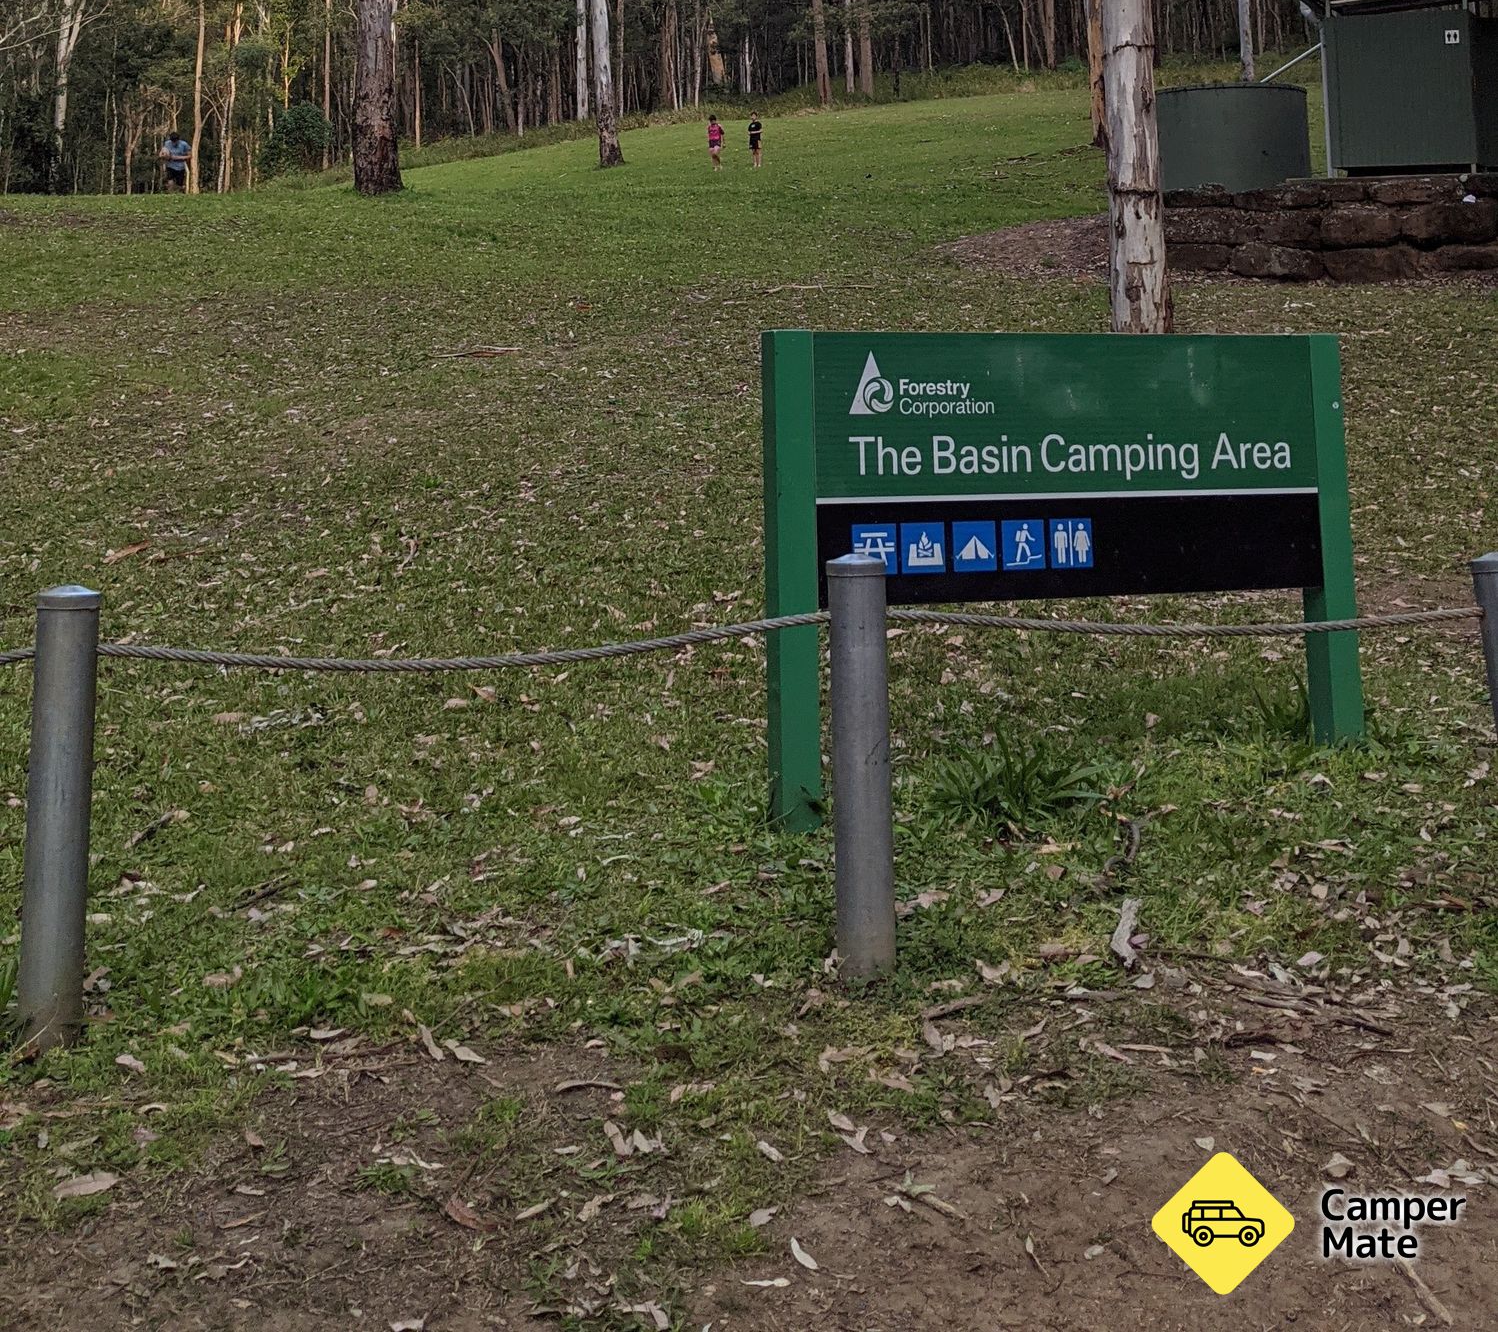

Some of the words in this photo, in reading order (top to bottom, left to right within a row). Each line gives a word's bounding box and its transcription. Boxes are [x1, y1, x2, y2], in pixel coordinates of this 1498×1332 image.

[899, 379, 970, 399] Forestry
[899, 397, 995, 418] Corporation
[849, 436, 923, 476] The
[932, 435, 1032, 474] Basin
[1040, 433, 1199, 480] Camping
[1211, 432, 1291, 469] Area
